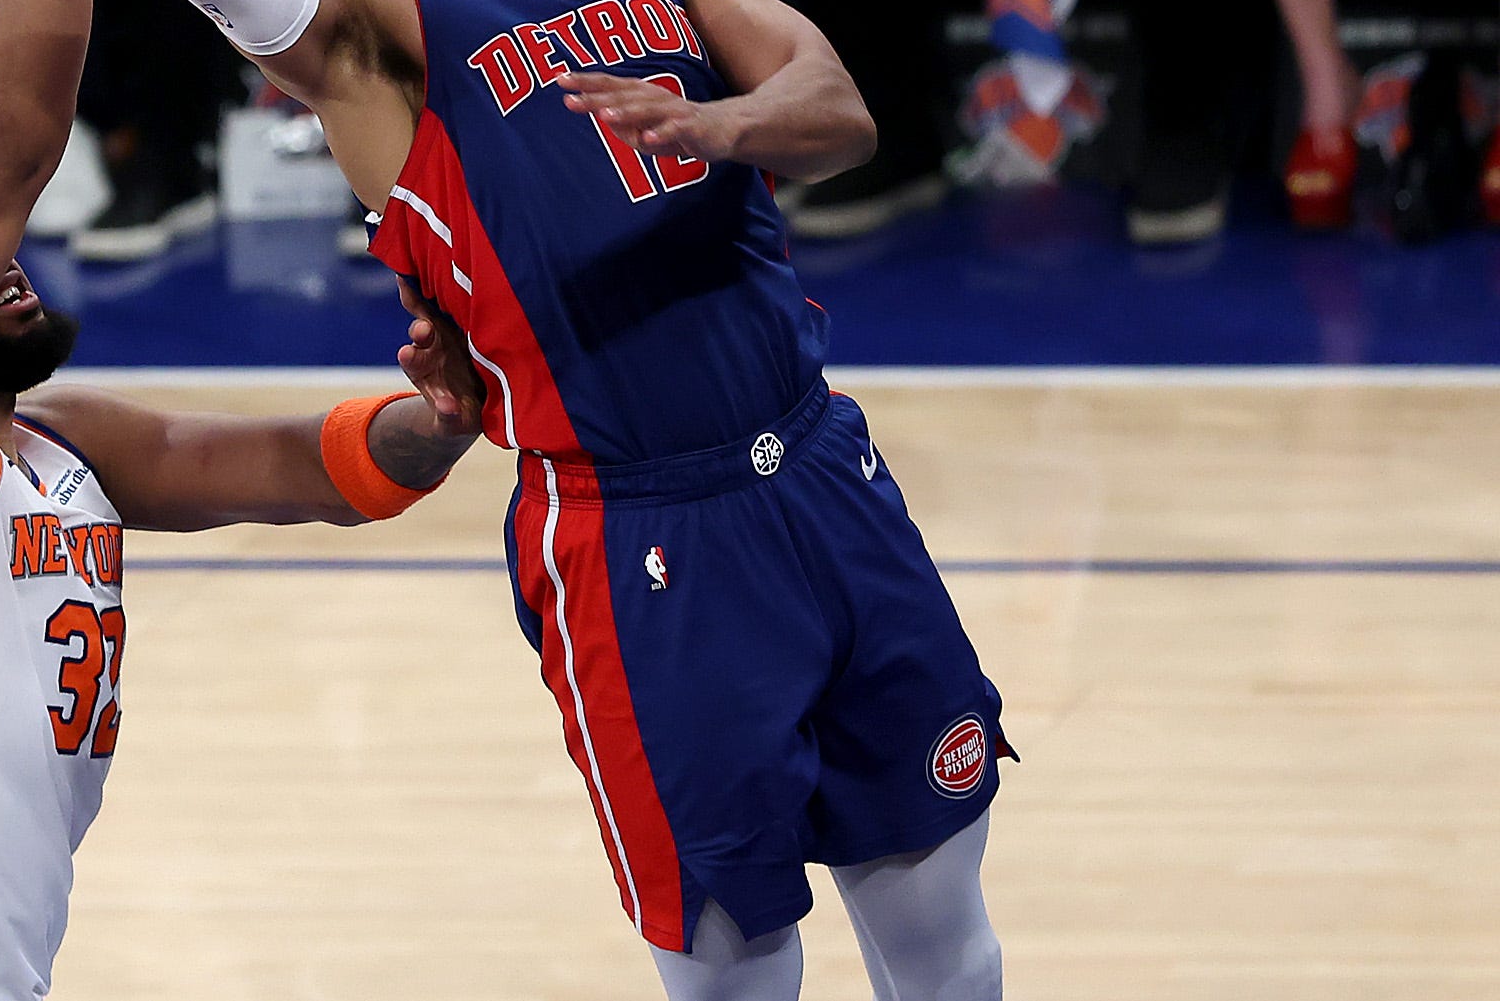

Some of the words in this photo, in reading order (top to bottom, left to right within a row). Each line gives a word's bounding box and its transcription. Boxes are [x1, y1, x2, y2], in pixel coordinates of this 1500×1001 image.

[59, 483, 78, 505] abu
[9, 511, 68, 581] NE
[44, 598, 127, 759] 32
[942, 733, 981, 766] DETROIT
[943, 745, 983, 778] PISTONS
